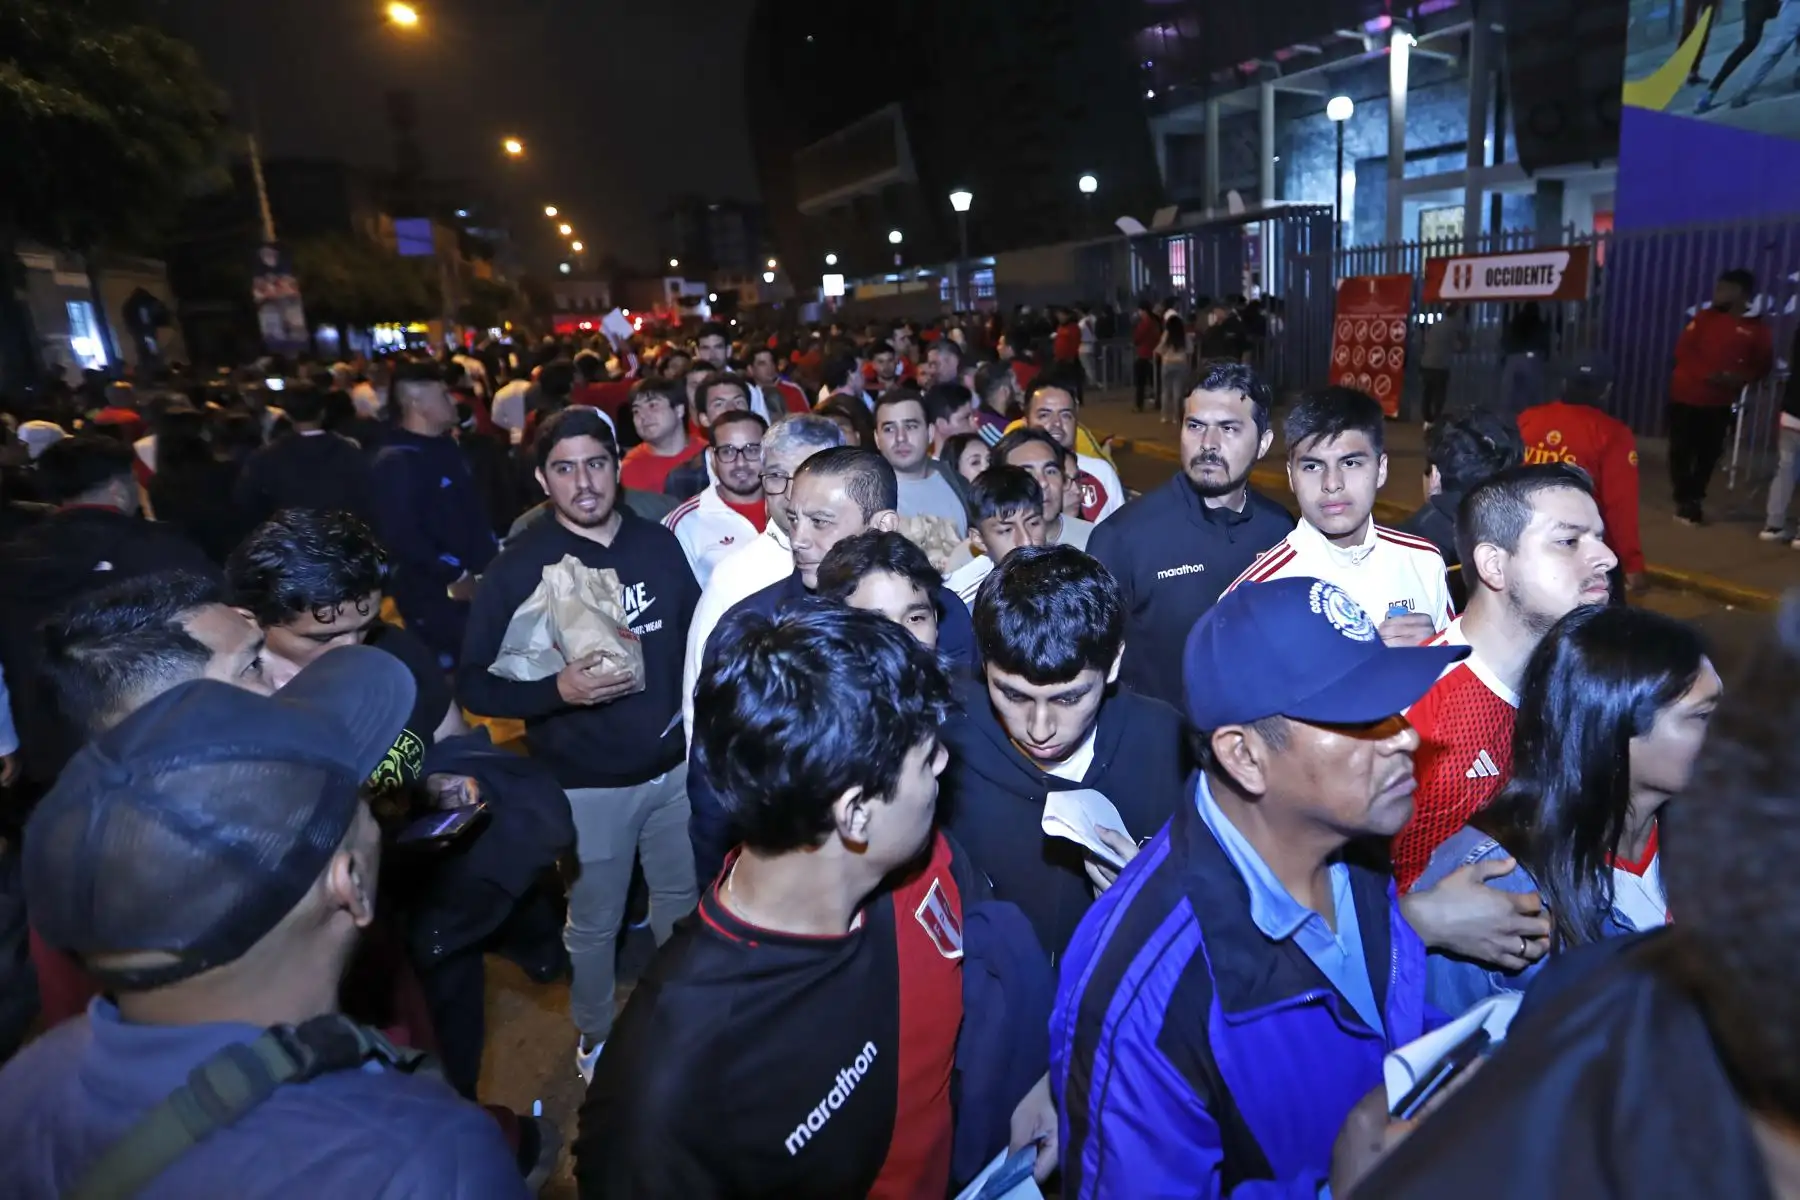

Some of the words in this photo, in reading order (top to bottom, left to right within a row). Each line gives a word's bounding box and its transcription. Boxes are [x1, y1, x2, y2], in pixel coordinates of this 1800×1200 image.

[1485, 264, 1555, 288] OCCIDENTE
[1157, 563, 1205, 580] marathon
[784, 1040, 878, 1156] marathon
